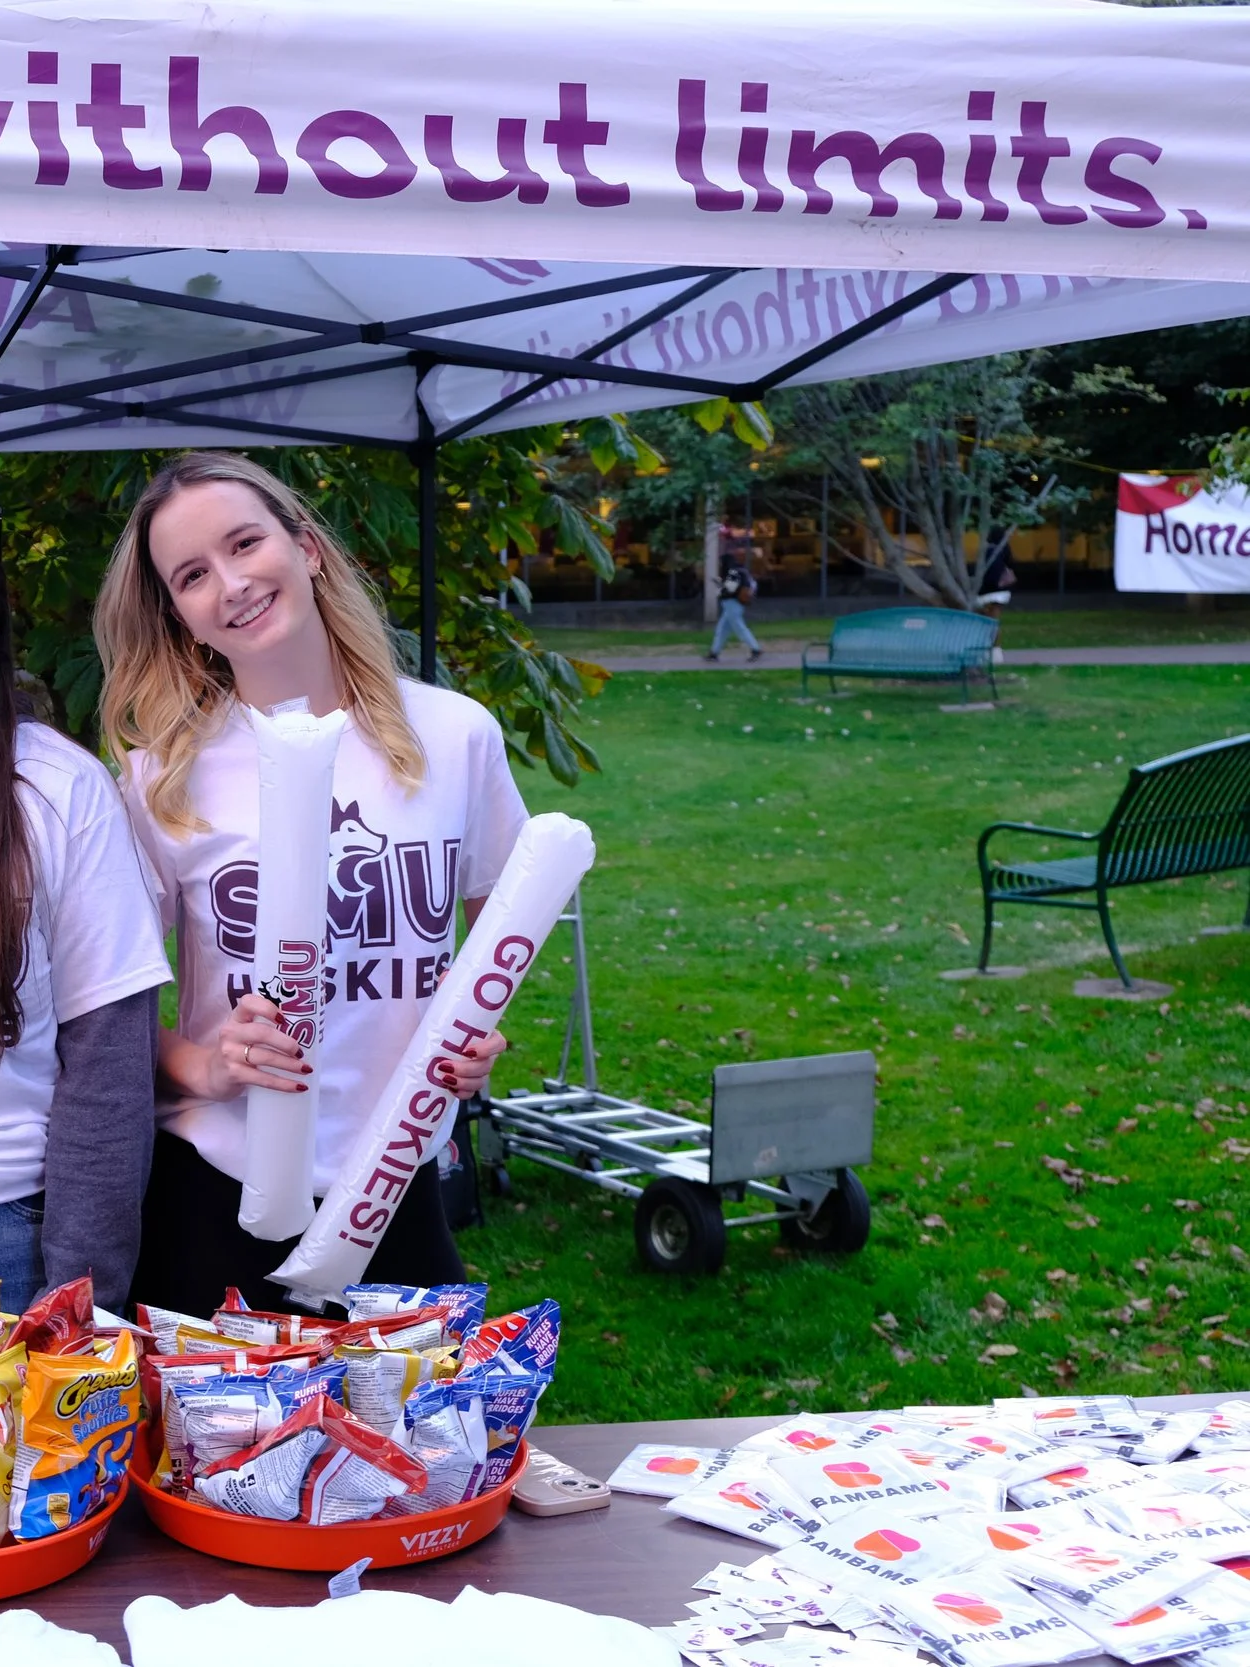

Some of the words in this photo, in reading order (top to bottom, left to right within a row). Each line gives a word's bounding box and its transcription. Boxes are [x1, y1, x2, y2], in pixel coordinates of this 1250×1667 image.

[675, 78, 1208, 230] limits.
[209, 838, 462, 962] SMU
[227, 952, 452, 1011] HSKIES
[473, 935, 535, 1011] GO
[339, 1018, 488, 1250] HUSKIES!
[525, 1318, 552, 1350] RUFFLES
[534, 1331, 554, 1353] HAVE
[534, 1335, 559, 1367] RRRIDG
[56, 1364, 138, 1418] Cheetos
[294, 1381, 328, 1400] RUFFLES
[493, 1397, 519, 1406] HAVE
[486, 1457, 513, 1468] UFFLES
[810, 1481, 938, 1509] BAMBAMS
[400, 1520, 473, 1551] VIZZY
